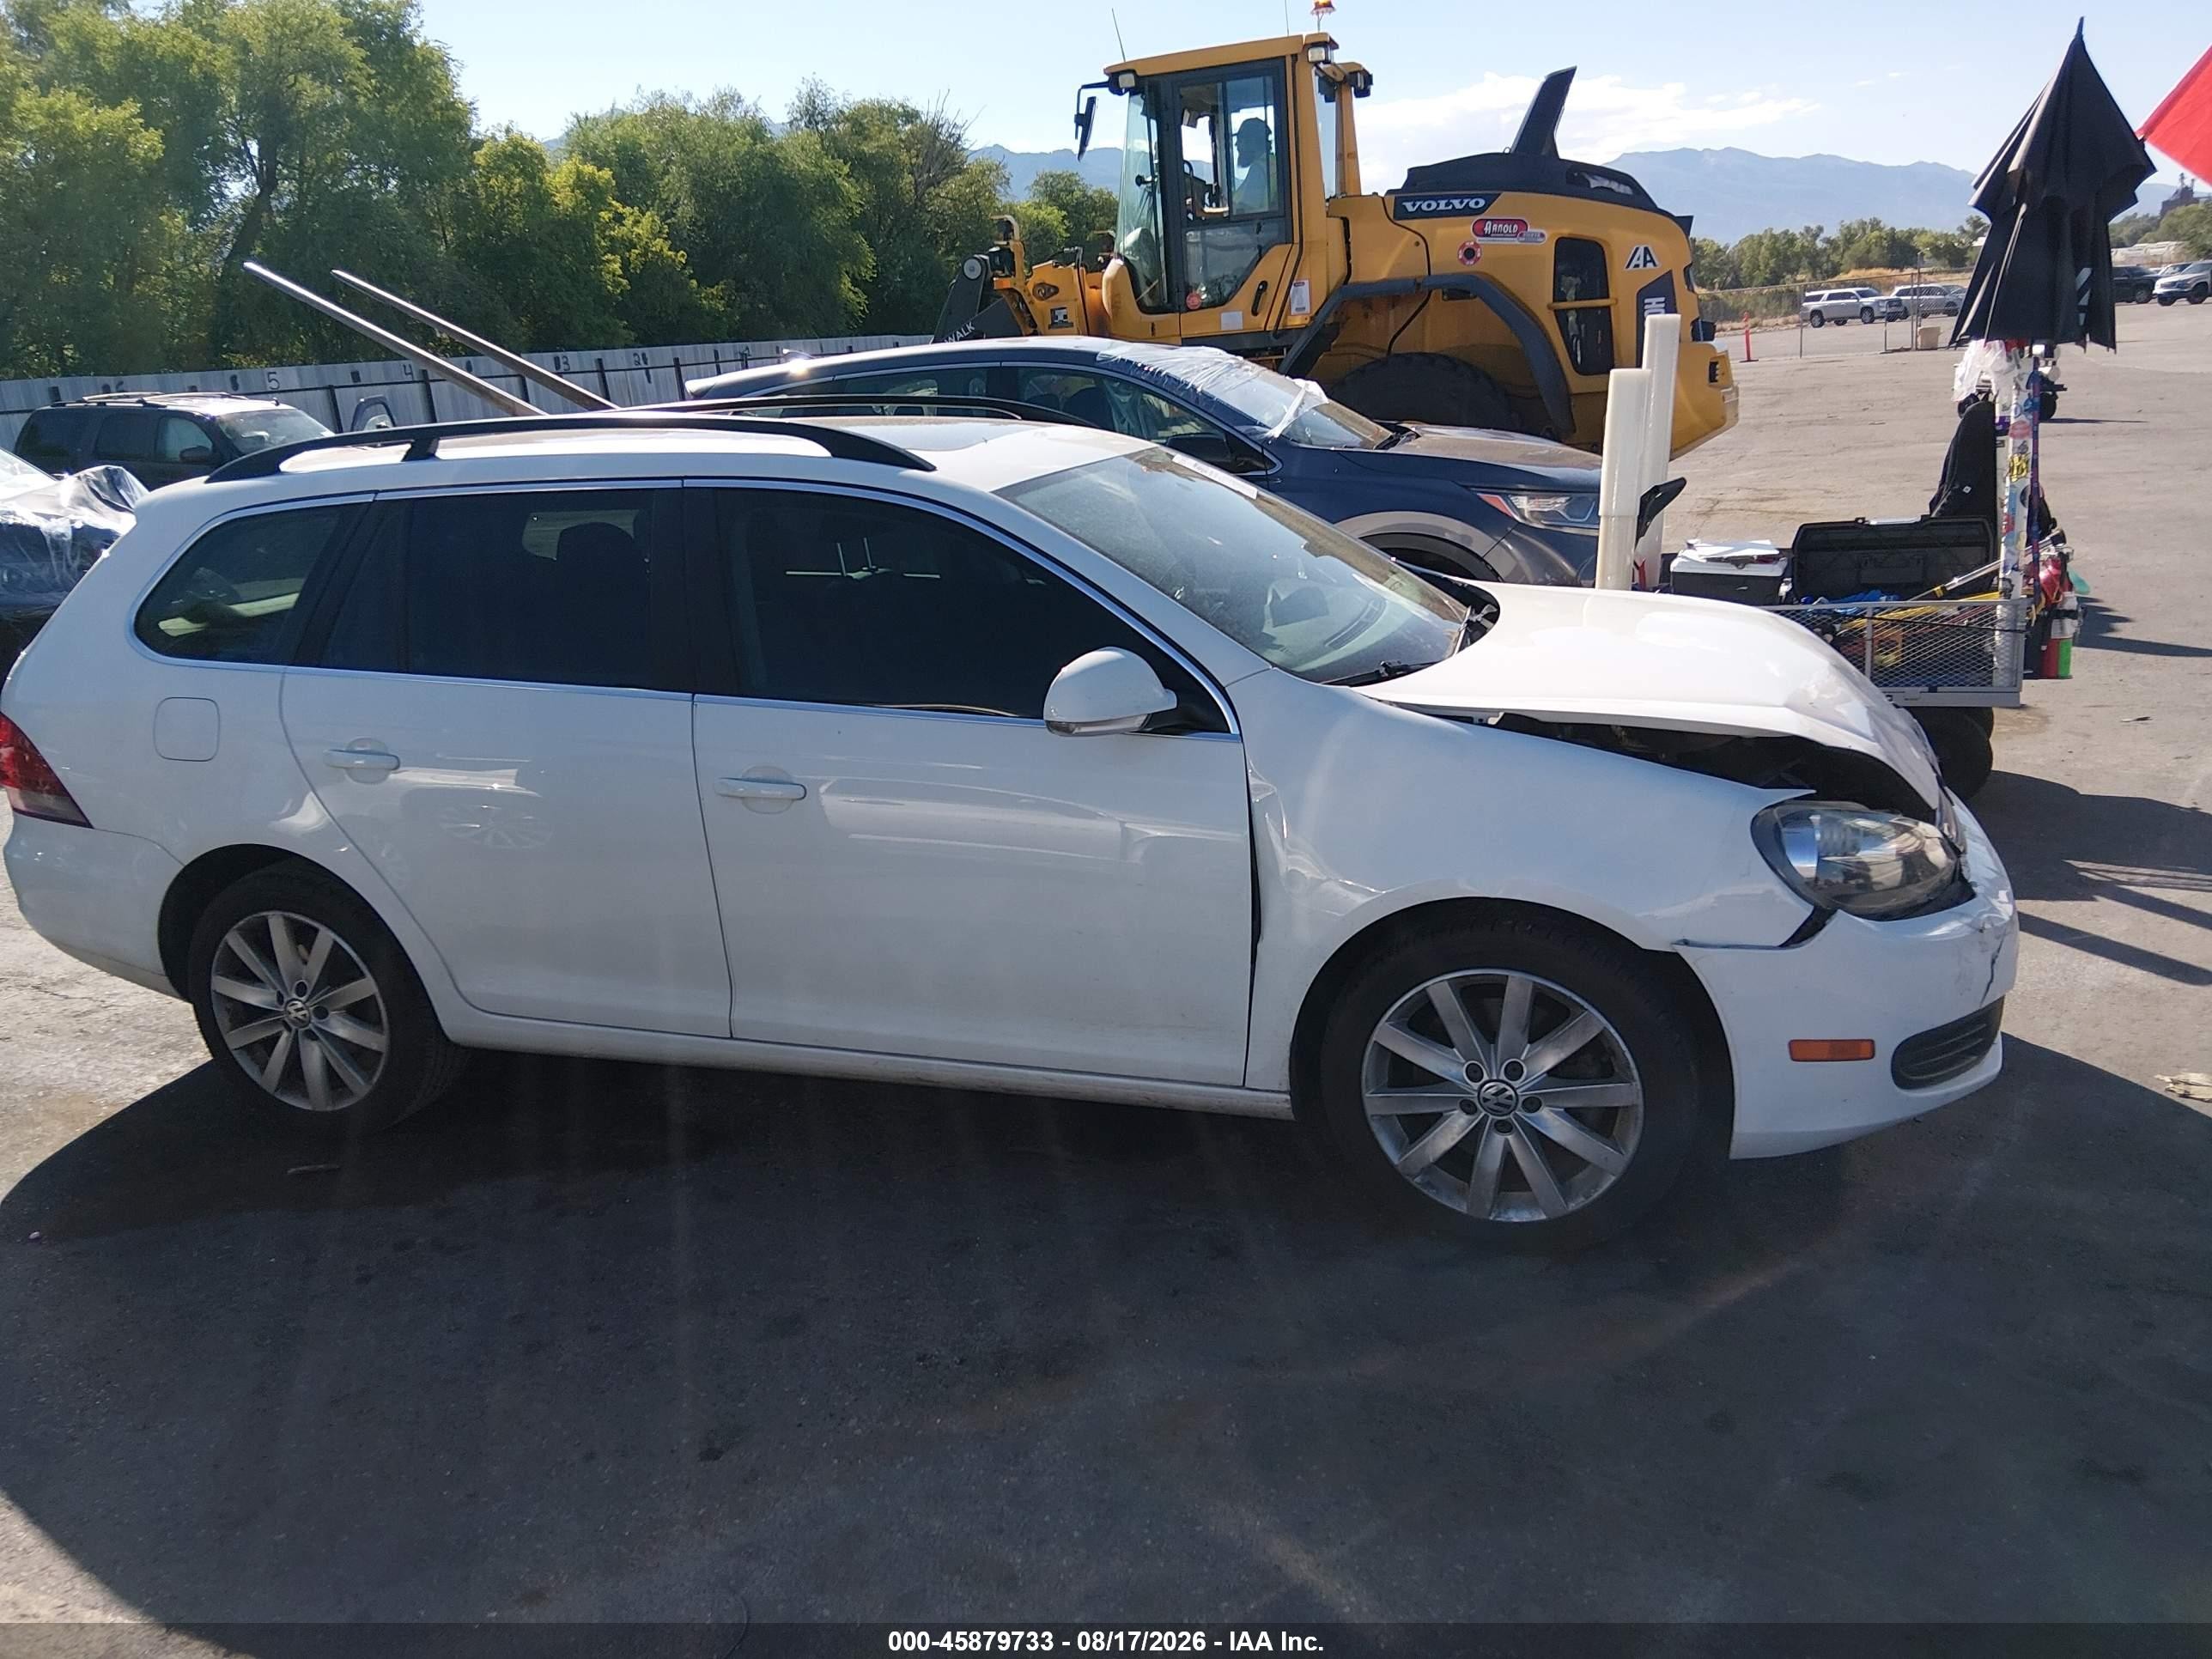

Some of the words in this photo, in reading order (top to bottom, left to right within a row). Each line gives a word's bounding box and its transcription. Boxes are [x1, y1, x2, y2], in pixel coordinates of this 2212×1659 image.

[1402, 198, 1486, 212] VOLVO
[1483, 221, 1518, 235] ARNOLD
[402, 363, 415, 381] 4
[562, 355, 571, 372] 3
[267, 371, 281, 391] 5
